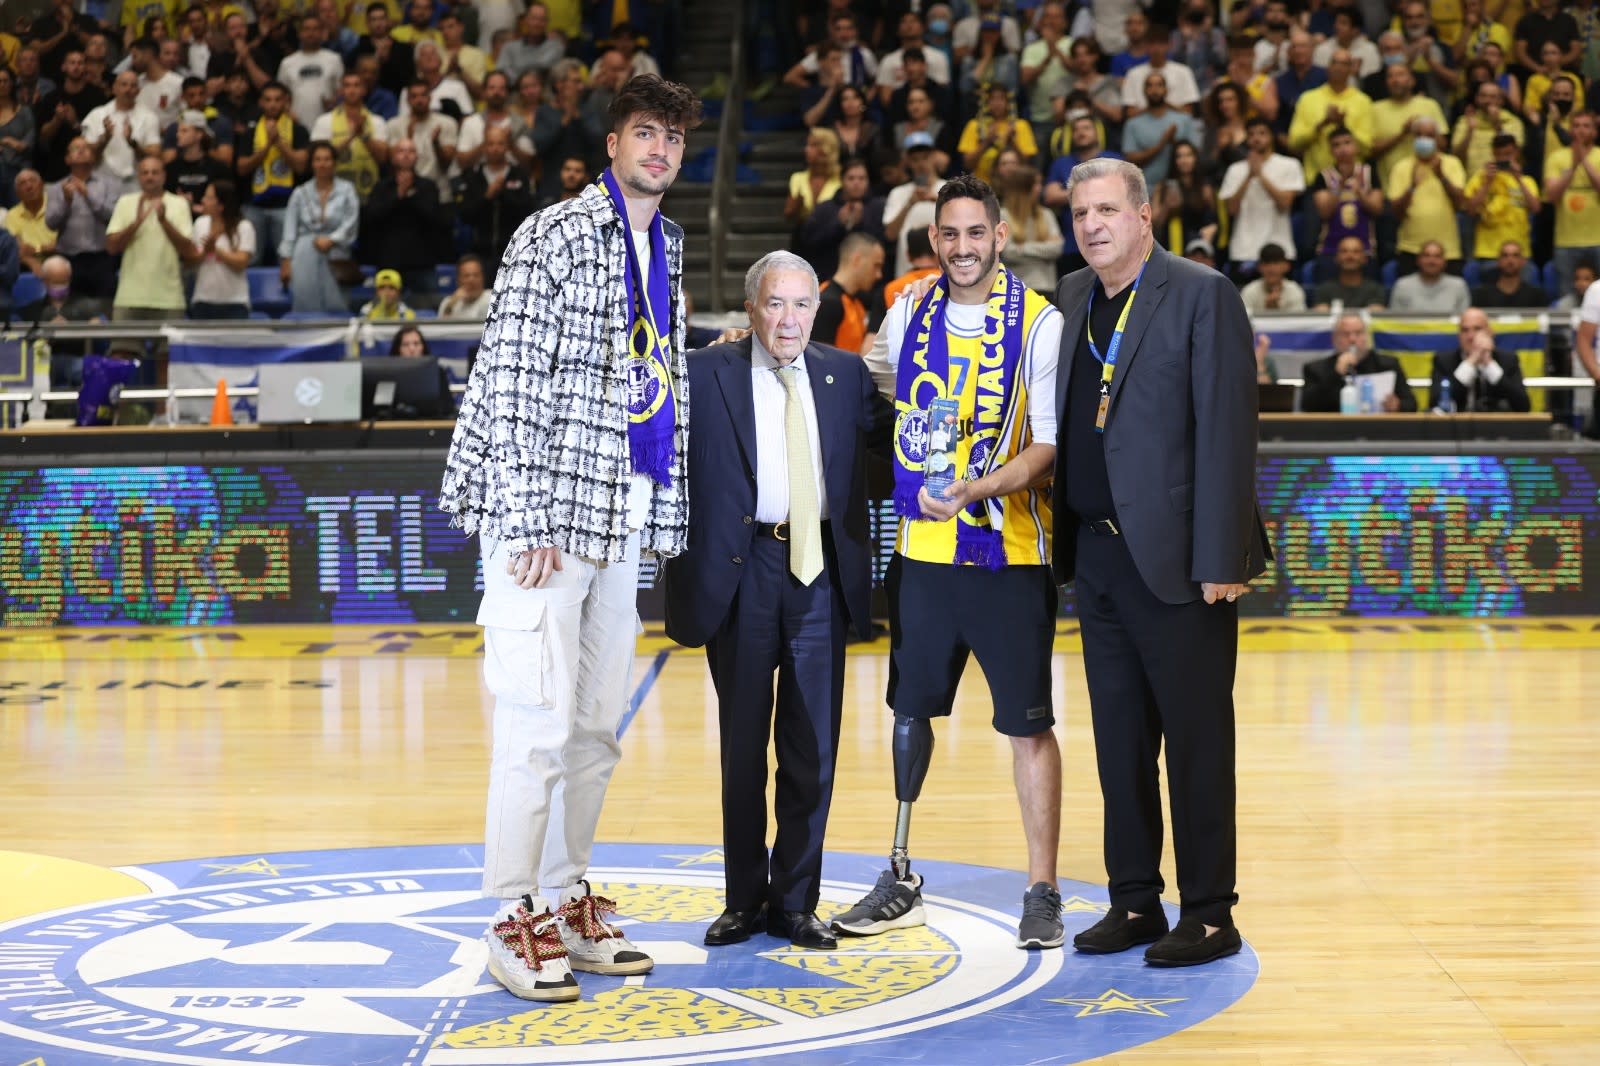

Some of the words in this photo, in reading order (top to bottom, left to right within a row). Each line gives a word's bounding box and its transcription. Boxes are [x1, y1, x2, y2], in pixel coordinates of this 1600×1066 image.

[949, 356, 971, 396] 7
[305, 495, 448, 593] TEL
[261, 878, 425, 898] מכבי
[170, 995, 306, 1009] 1932
[8, 999, 311, 1055] MACCABI
